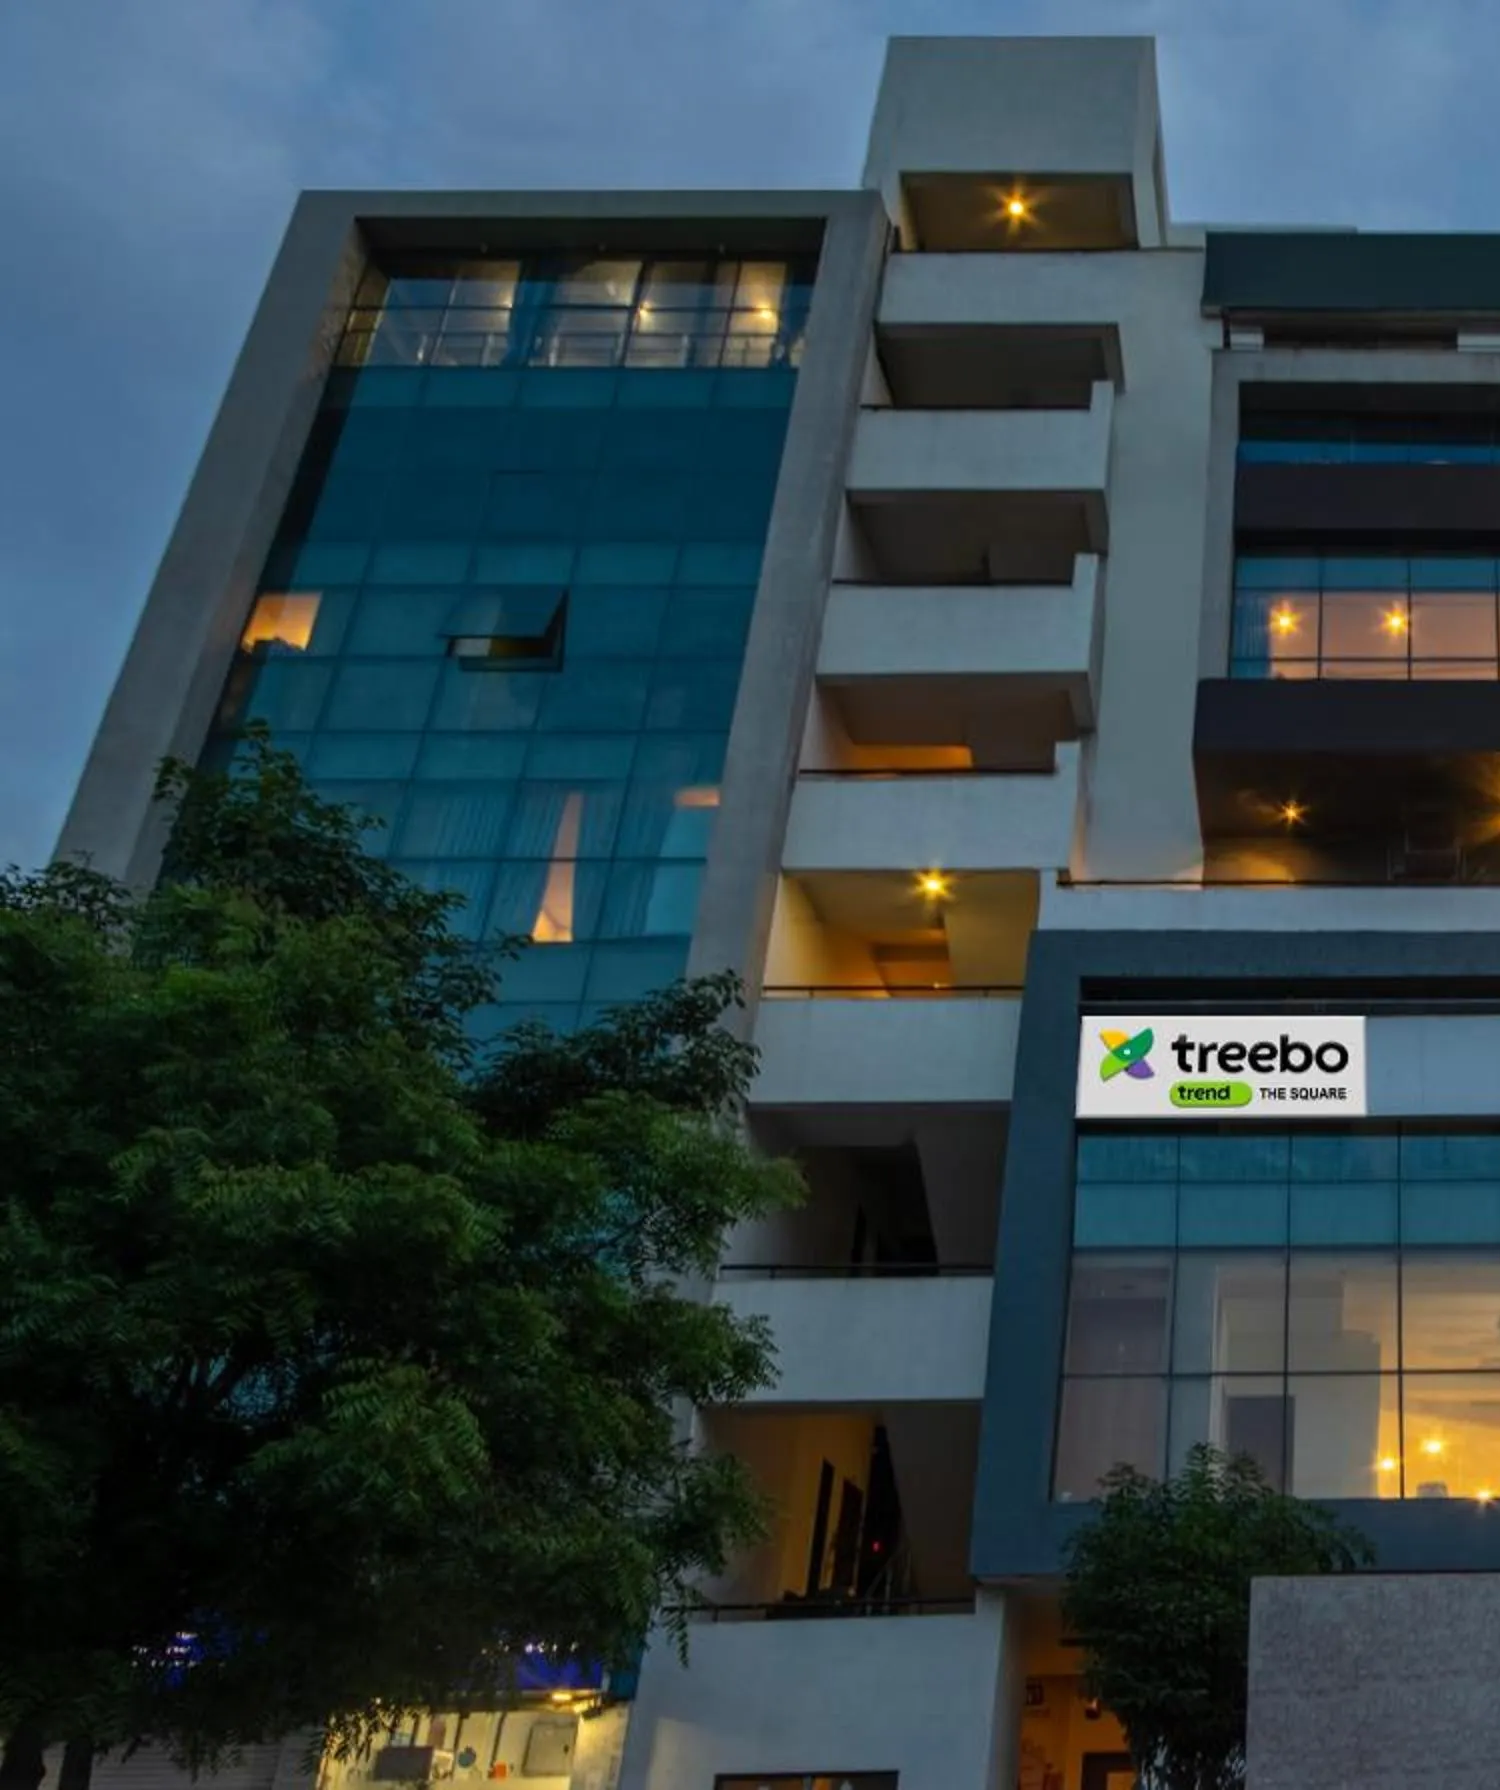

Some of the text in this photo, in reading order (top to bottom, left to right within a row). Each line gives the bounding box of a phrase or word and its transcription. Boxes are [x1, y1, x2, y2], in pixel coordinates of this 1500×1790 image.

[1171, 1034, 1349, 1073] treebo
[1177, 1085, 1230, 1100] trend
[1260, 1087, 1347, 1100] THE SQUARE
